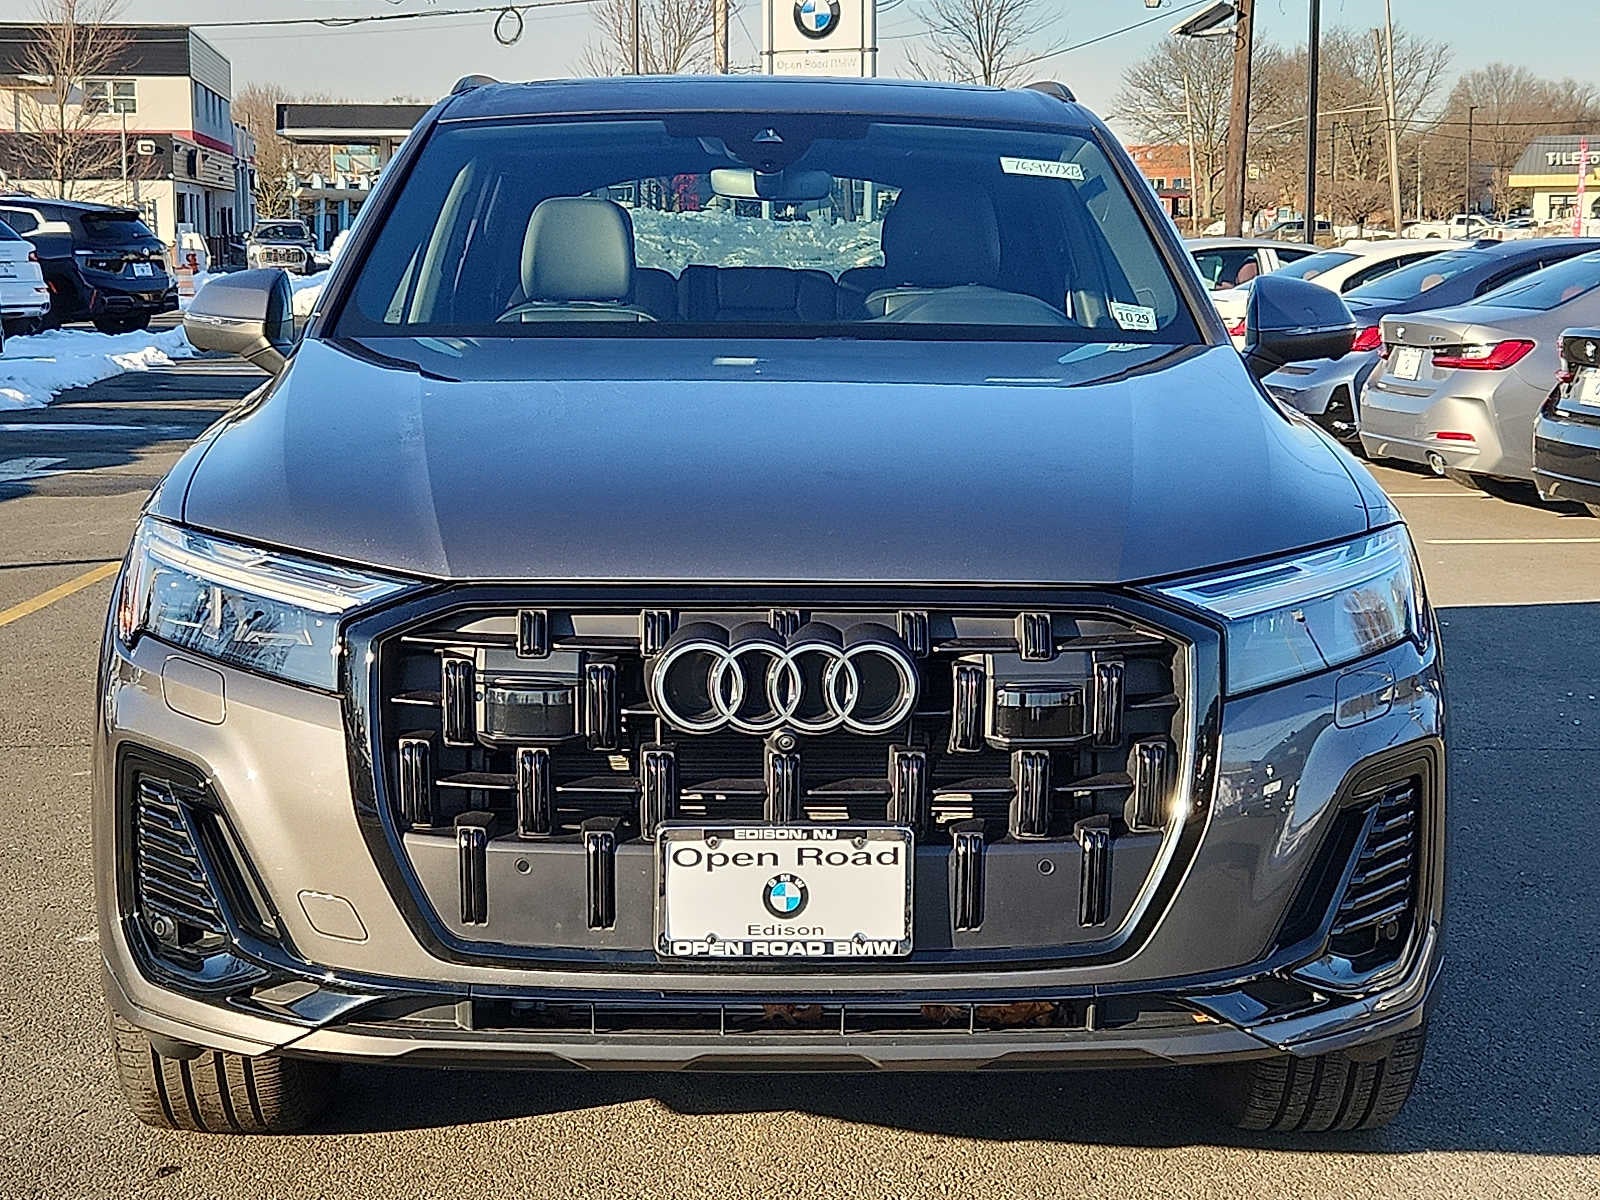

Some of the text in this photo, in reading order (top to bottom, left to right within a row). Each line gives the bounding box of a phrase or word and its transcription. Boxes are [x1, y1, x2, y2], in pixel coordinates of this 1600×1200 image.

[776, 60, 801, 71] Open
[1118, 311, 1150, 324] 10 29
[734, 829, 838, 840] EDISON, NJ
[672, 846, 899, 872] Open Road
[767, 874, 806, 889] BMW
[747, 924, 824, 936] Edison
[672, 941, 898, 956] OPEN ROAD BMW
